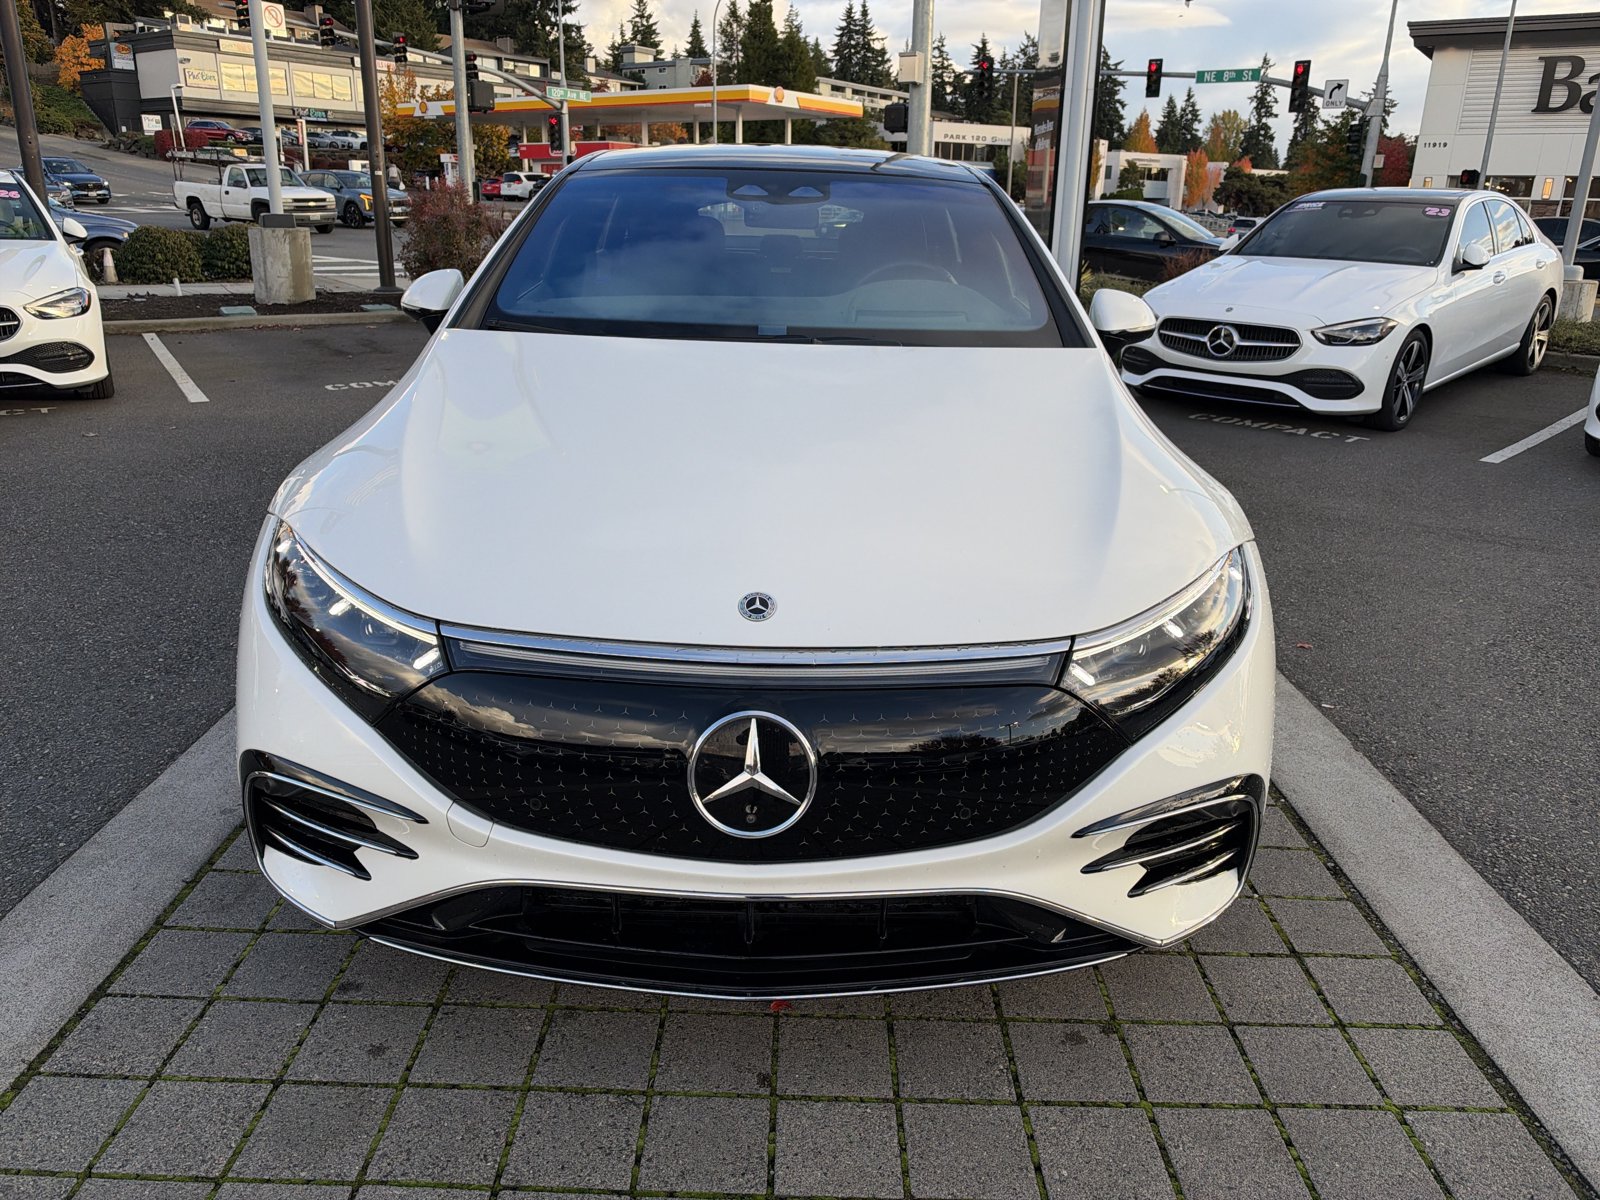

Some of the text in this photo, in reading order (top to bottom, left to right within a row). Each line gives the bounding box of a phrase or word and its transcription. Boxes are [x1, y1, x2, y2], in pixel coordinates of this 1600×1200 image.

[1203, 70, 1253, 83] NE 8th St
[943, 133, 967, 141] PARK
[971, 135, 987, 143] 120
[1188, 413, 1371, 443] COMPACT
